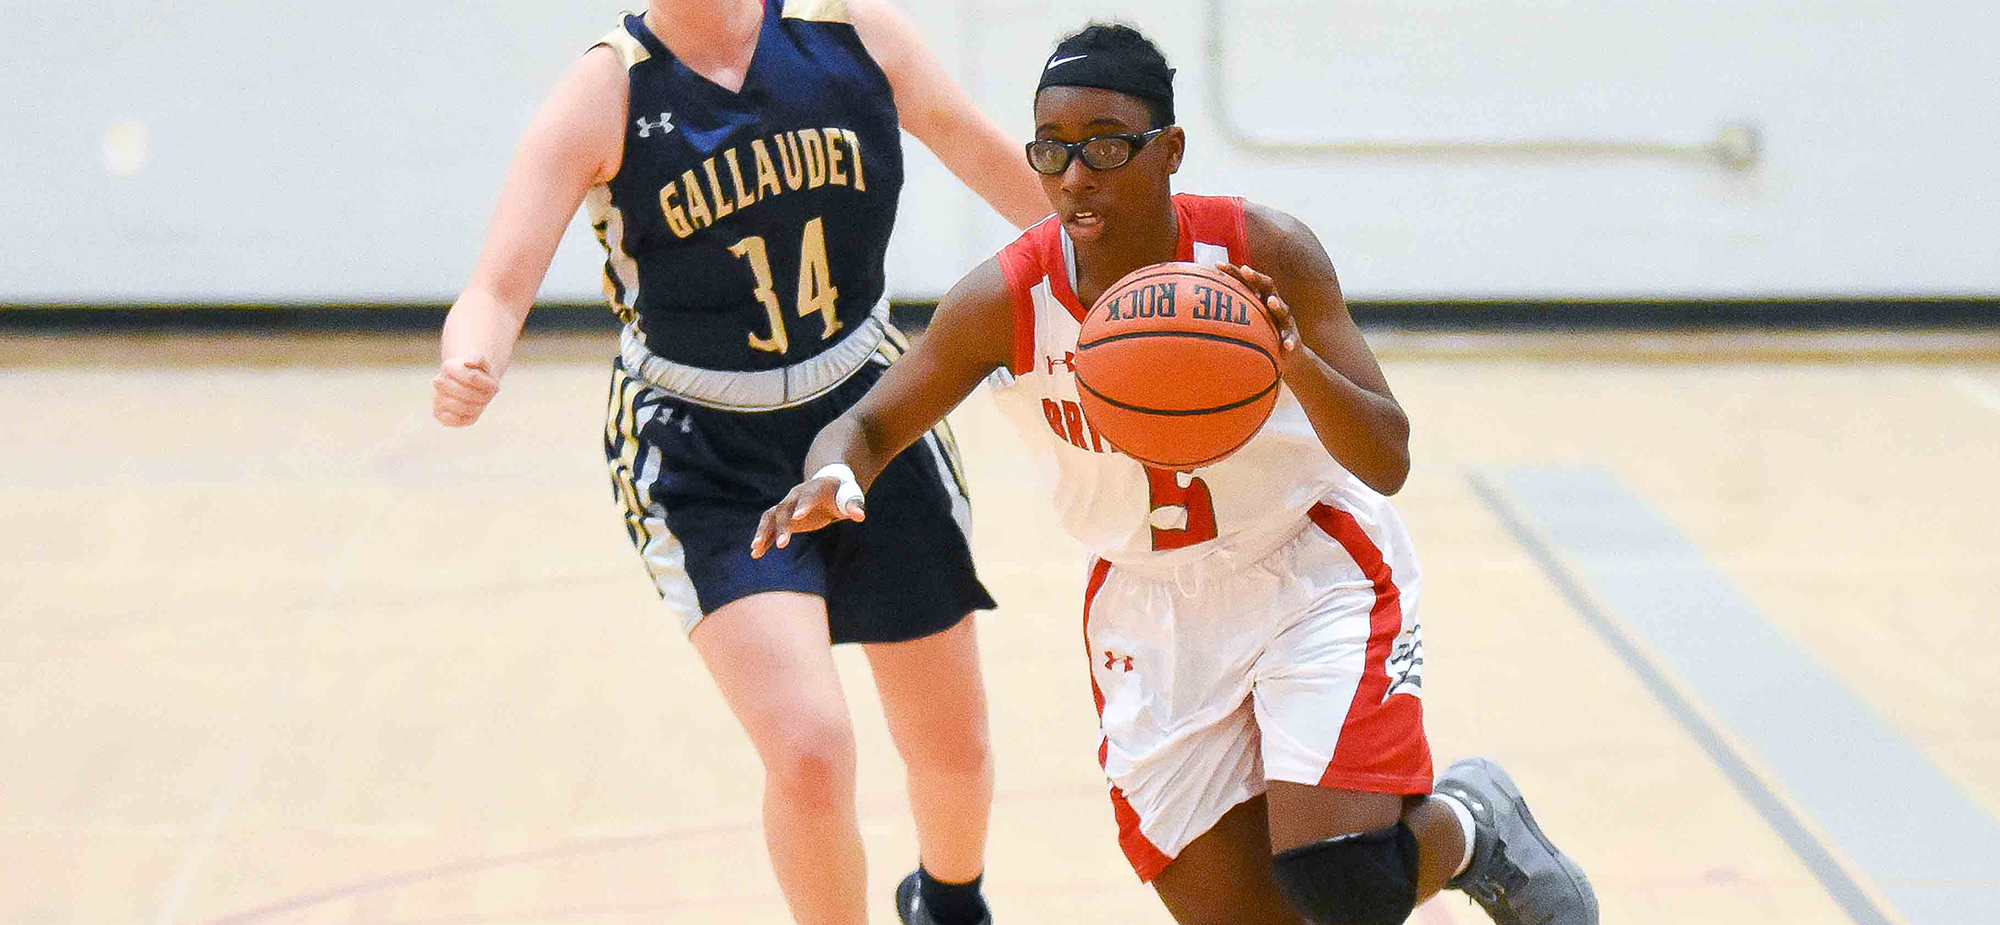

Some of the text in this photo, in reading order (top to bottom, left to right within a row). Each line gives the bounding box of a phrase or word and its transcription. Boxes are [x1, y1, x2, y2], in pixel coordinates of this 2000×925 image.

[659, 127, 866, 239] GALLAUDET
[727, 216, 844, 355] 34
[1105, 283, 1251, 326] THE ROCK
[1041, 398, 1120, 453] BR
[1142, 464, 1219, 552] 5
